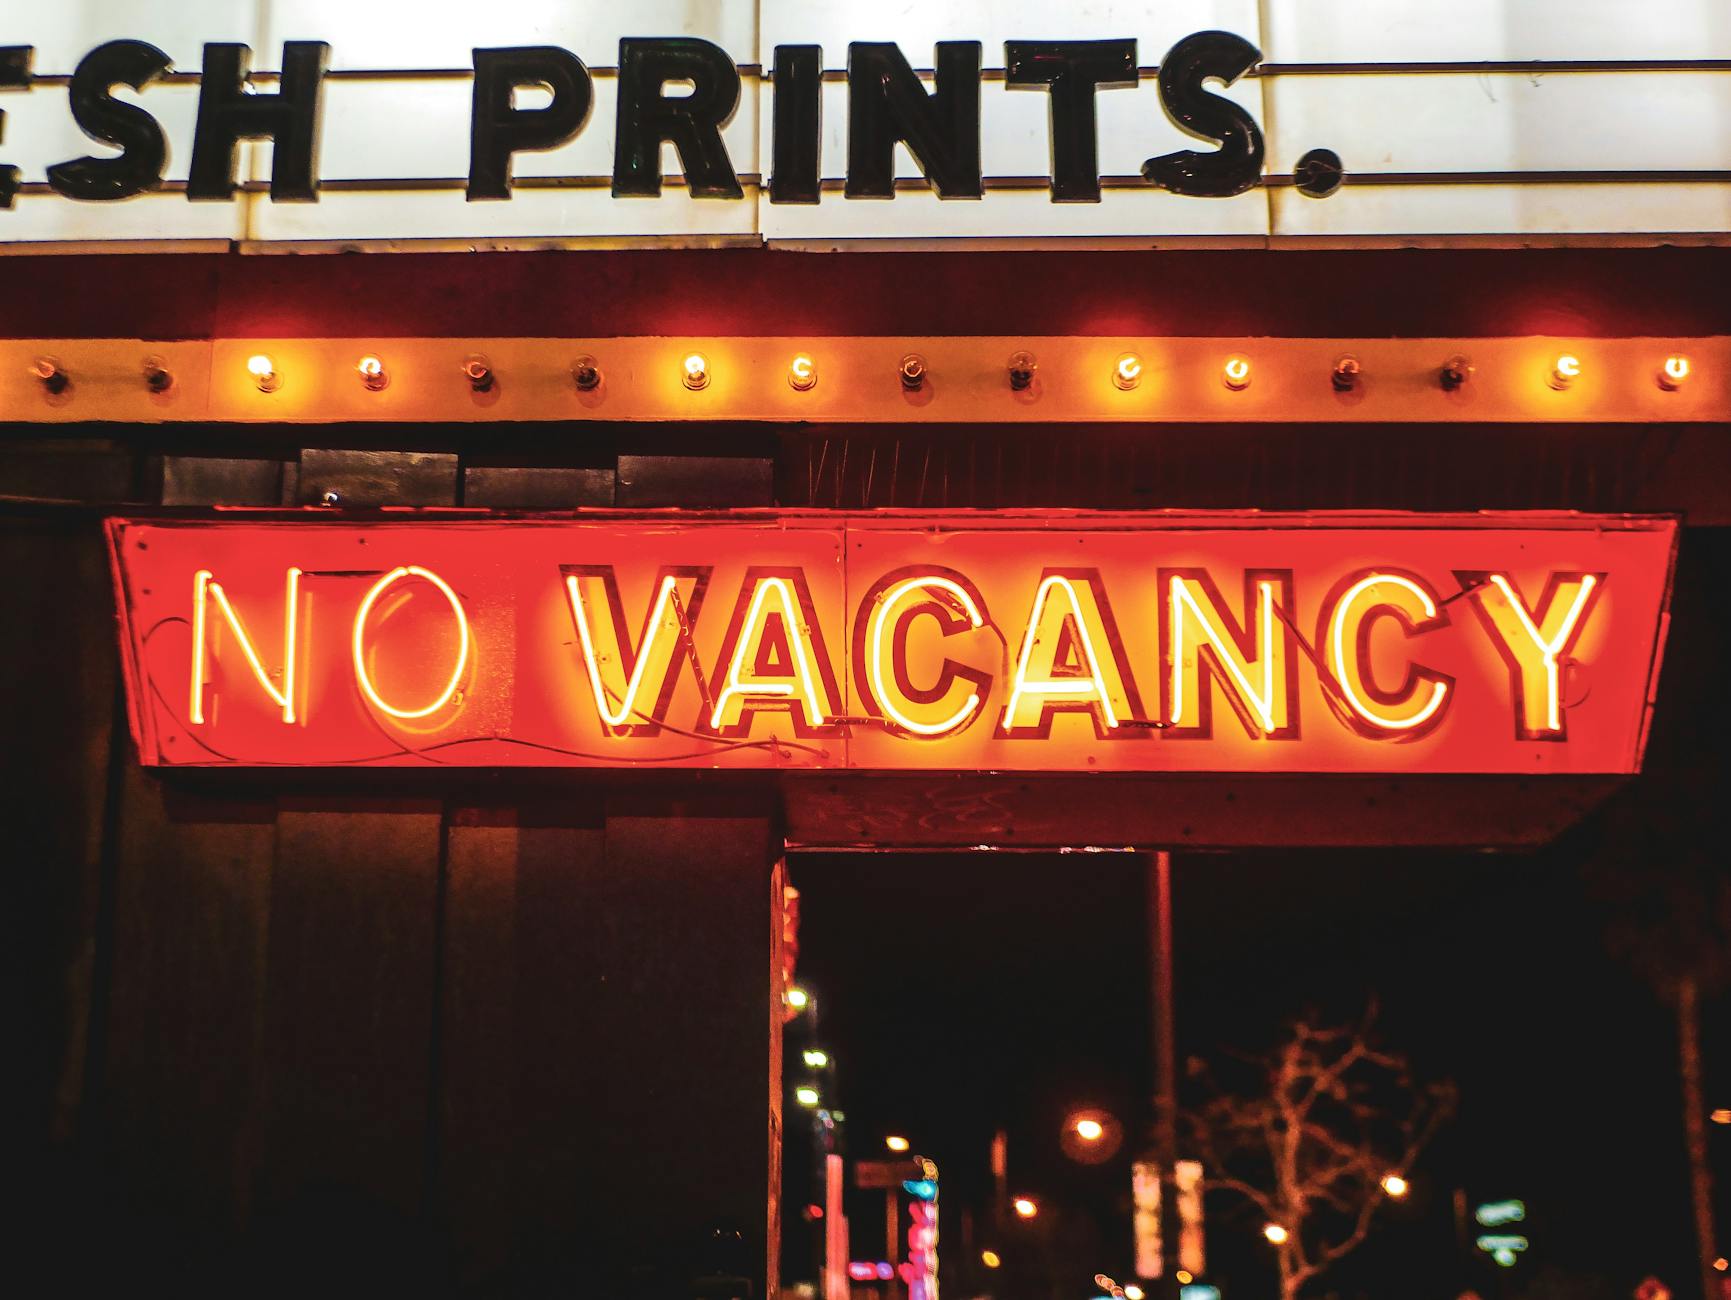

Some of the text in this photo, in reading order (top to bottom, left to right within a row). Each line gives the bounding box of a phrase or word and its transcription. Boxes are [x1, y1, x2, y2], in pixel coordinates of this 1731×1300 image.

[466, 30, 1345, 206] PRINTS.
[187, 562, 1609, 746] NO VACANCY
